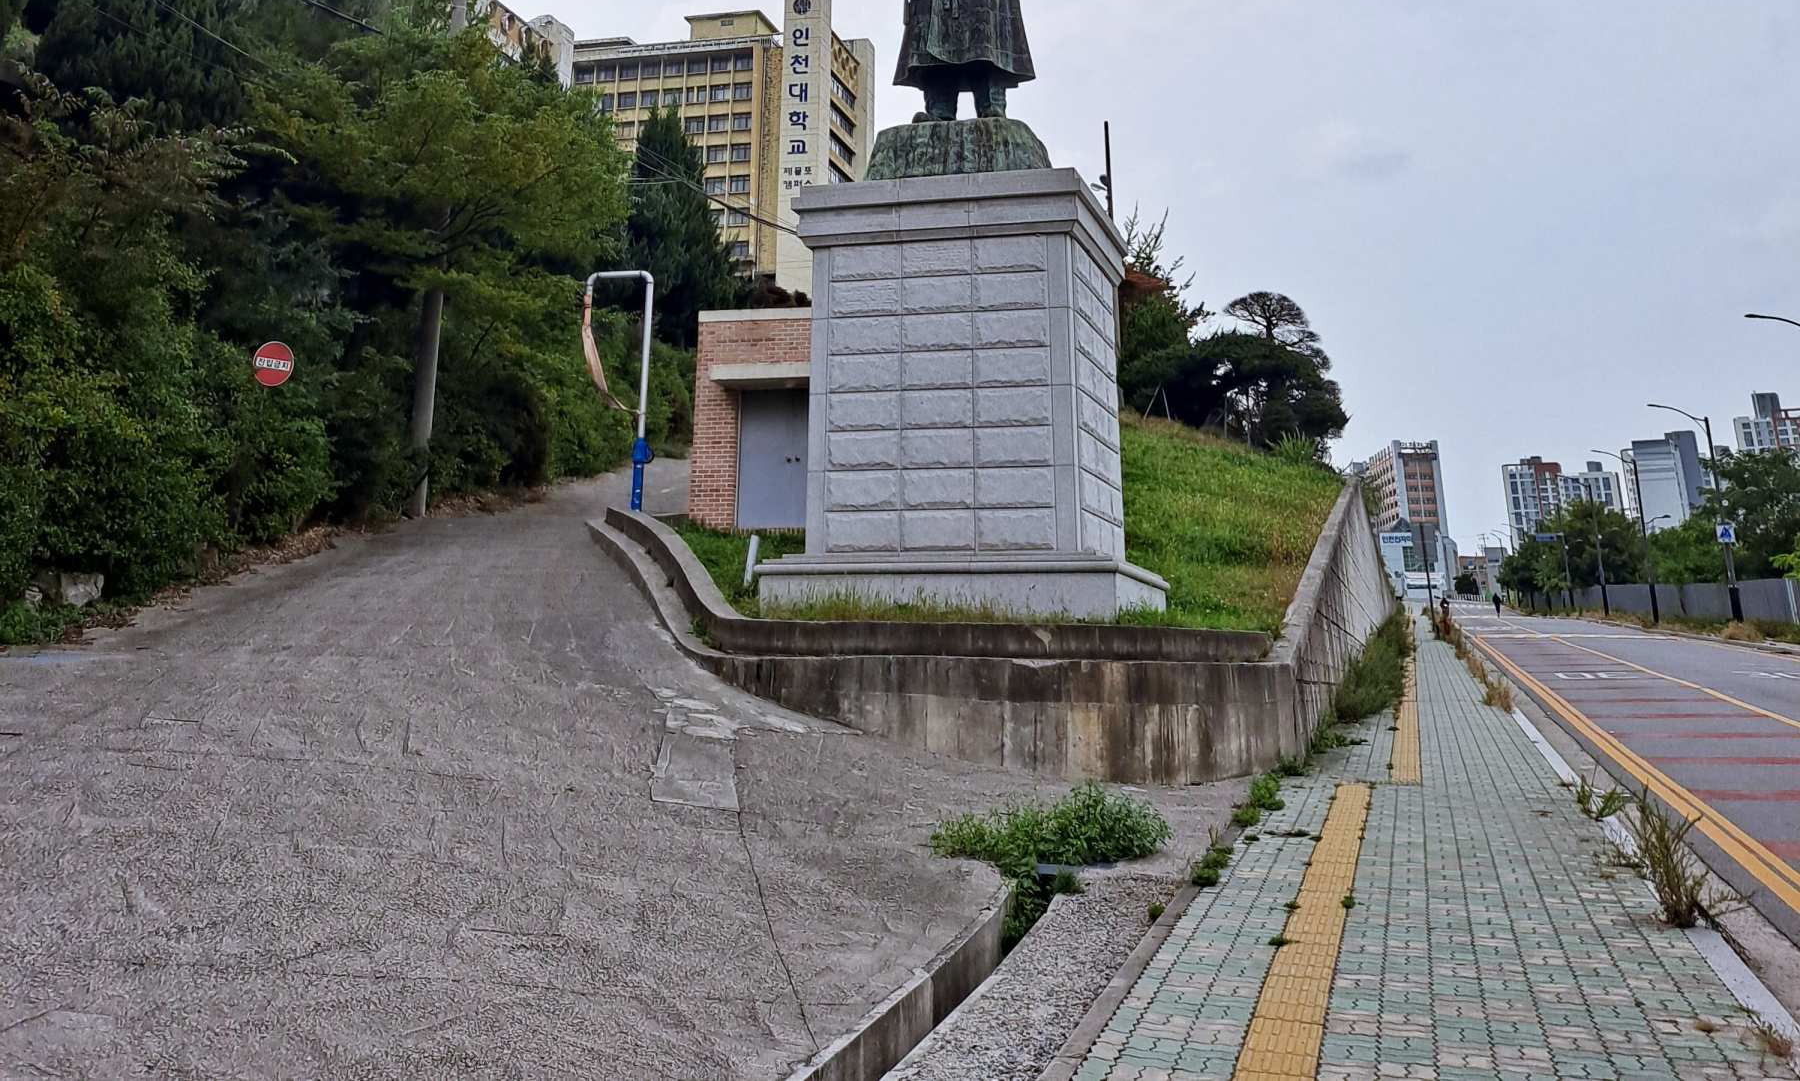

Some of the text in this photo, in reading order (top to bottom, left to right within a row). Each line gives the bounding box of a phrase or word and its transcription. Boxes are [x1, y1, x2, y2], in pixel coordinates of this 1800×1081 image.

[787, 27, 810, 155] 인천대학교
[783, 166, 813, 176] 제물포
[783, 179, 813, 190] 캠퍼스
